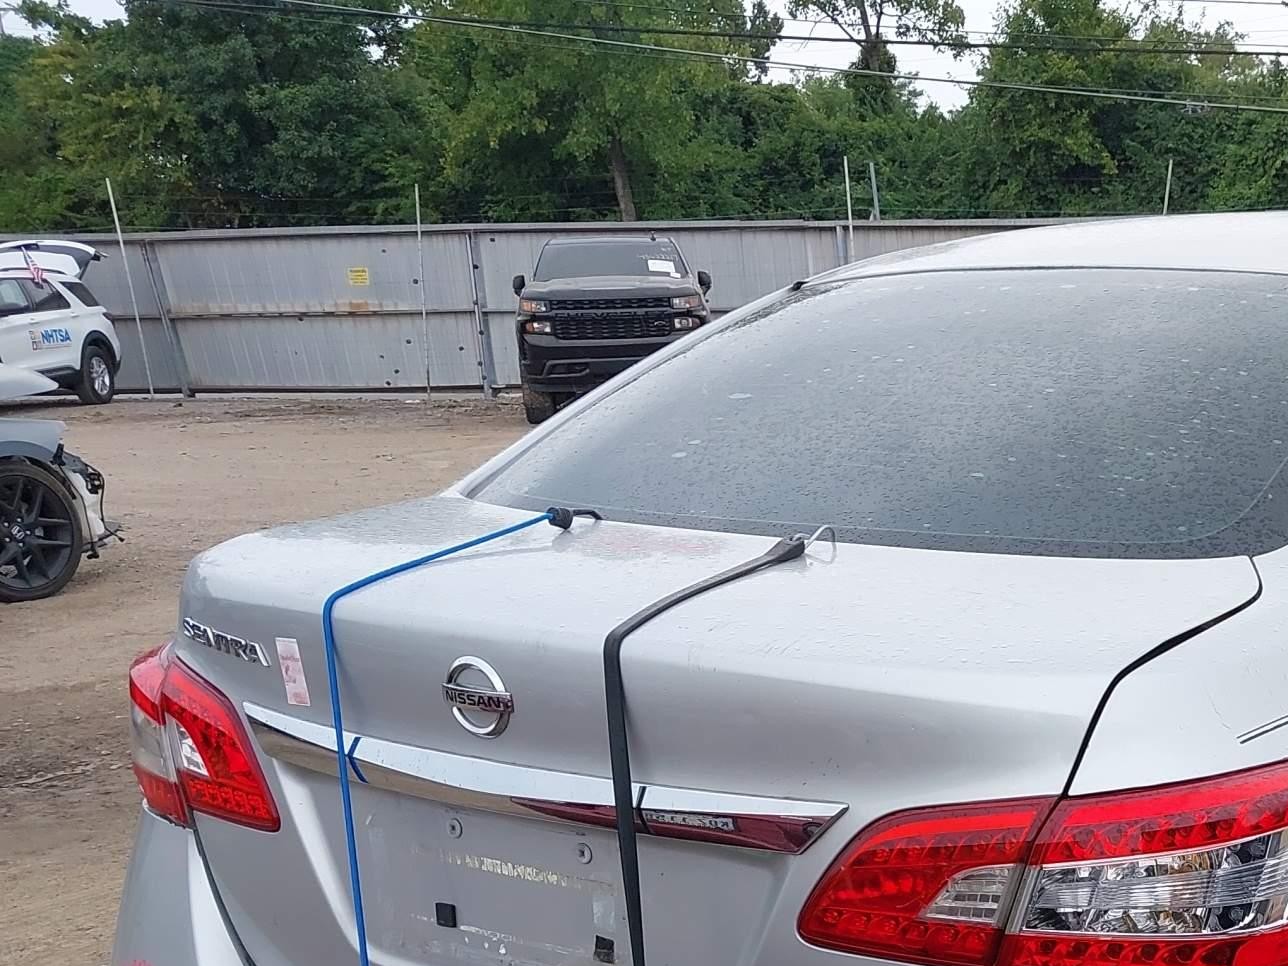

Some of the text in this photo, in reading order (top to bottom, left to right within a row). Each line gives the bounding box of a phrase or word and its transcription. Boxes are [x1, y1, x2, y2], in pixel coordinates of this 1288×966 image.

[40, 328, 72, 344] NHTSA
[183, 617, 272, 667] SENTRA
[445, 690, 502, 708] NISSAN
